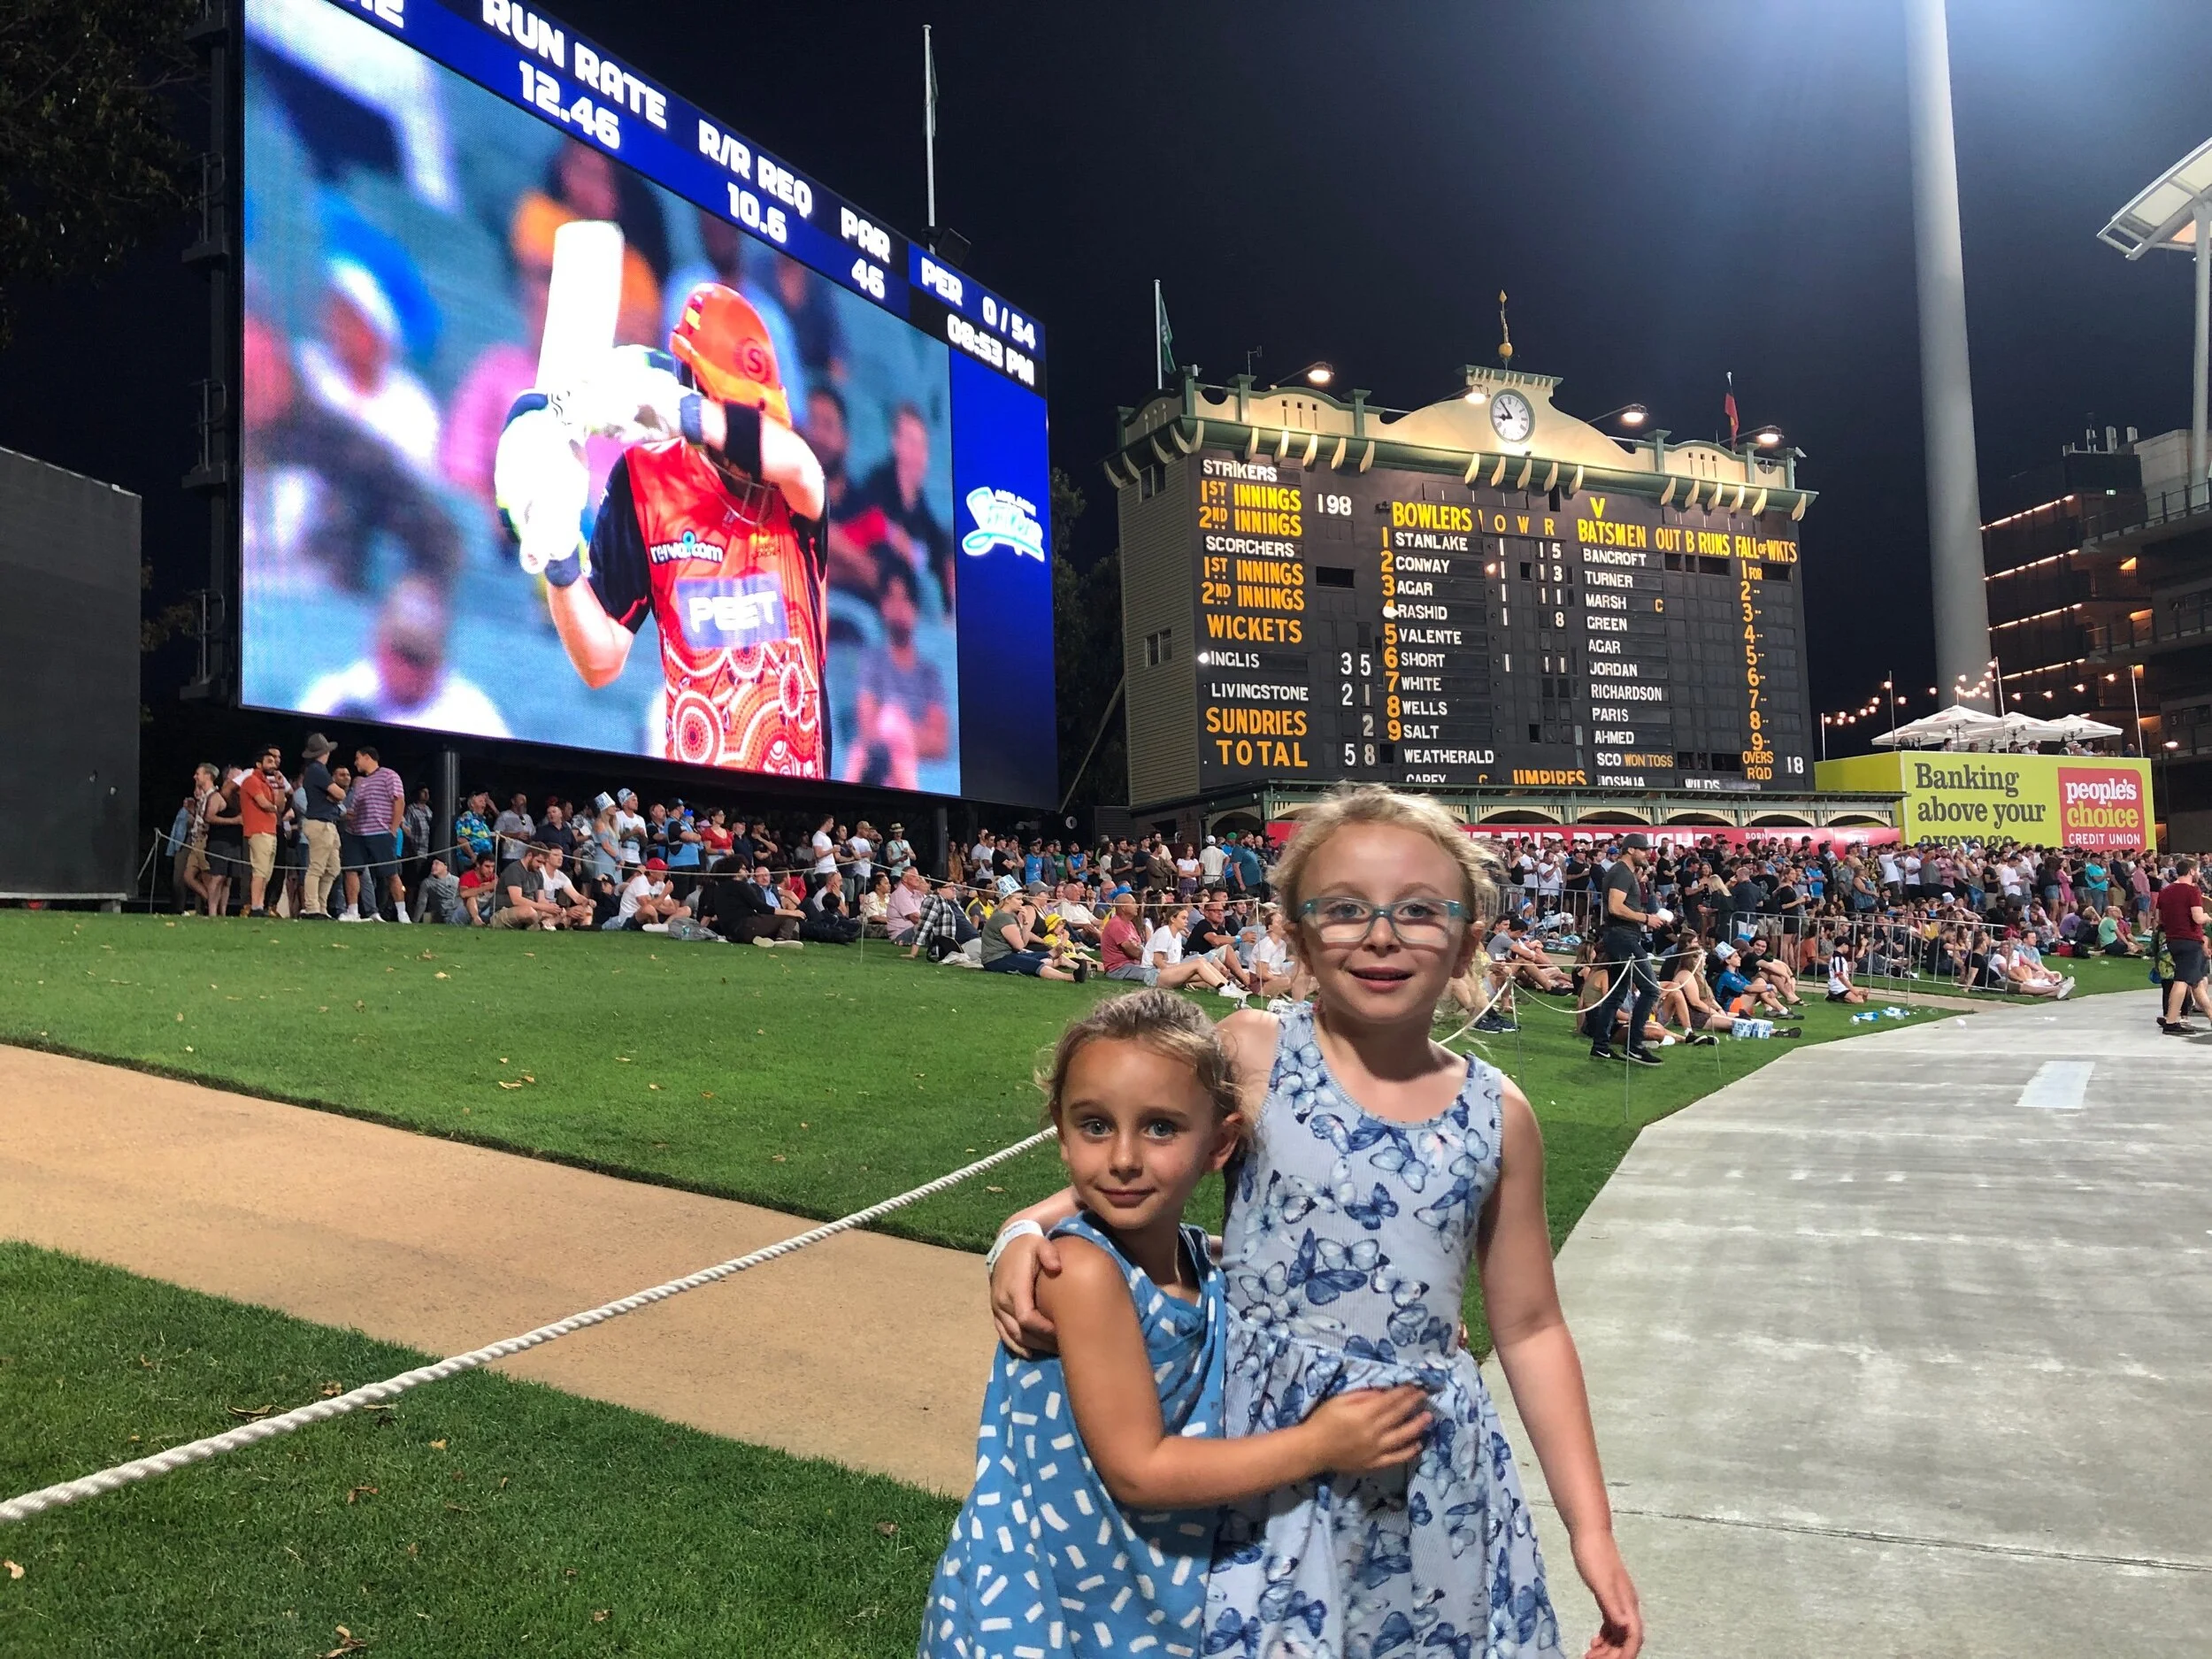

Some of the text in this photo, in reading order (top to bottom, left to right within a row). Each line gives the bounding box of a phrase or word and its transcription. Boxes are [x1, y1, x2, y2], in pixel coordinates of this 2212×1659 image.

[482, 0, 667, 129] RUN RATE
[518, 61, 620, 150] 12.46
[698, 119, 812, 218] R/R REQ
[727, 181, 787, 243] 10.6
[841, 206, 890, 264] PAR
[851, 258, 885, 299] 46
[921, 257, 963, 306] PER
[947, 313, 1034, 386] 08:53 PM
[1202, 459, 1277, 482] STRIKERS
[1202, 480, 1351, 516] 1ST INNINGS 198
[1590, 496, 1605, 518] V
[1199, 506, 1302, 537] 2ND INNINGS
[1392, 501, 1555, 535] BOWLERS O W R
[1205, 535, 1294, 558] SCORCHERS
[1382, 526, 1388, 548] 1
[1394, 531, 1468, 551] STANLAKE
[1577, 518, 1798, 564] BATSMEN OUT B RUNS FALL OF WKTS
[1380, 550, 1394, 572] 2
[1395, 556, 1450, 574] CONWAY
[1583, 548, 1647, 566] BANCROFT
[1203, 556, 1304, 586] 1ST INNINGS
[1585, 570, 1633, 588] TURNER
[1741, 559, 1763, 580] 1 FOR
[1201, 581, 1304, 611] 2ND INNINGS
[1381, 574, 1395, 597] 3
[1396, 580, 1432, 596] AGAR
[1740, 580, 1751, 601] 2
[688, 590, 778, 633] PEET
[1585, 594, 1663, 612] MARSH C
[1742, 603, 1754, 622] 3
[1398, 604, 1448, 620] RASHID
[1555, 612, 1564, 627] 8
[1586, 616, 1627, 632] GREEN
[1206, 613, 1302, 643] WICKETS
[1384, 623, 1462, 645] 5 VALENTE
[1744, 625, 1755, 643] 4
[1384, 646, 1398, 669] 6
[1401, 652, 1445, 668] SHORT
[1588, 639, 1621, 655] AGAR
[1746, 645, 1757, 665] 5
[1210, 650, 1260, 668] INGLIS
[1589, 662, 1637, 678] JORDAN
[1385, 671, 1442, 692] 7 WHITE
[1747, 667, 1759, 687] 6
[1211, 683, 1309, 702] LIVINGSTONE
[1591, 684, 1662, 702] RICHARDSON
[1748, 689, 1759, 709] 7
[1386, 695, 1448, 718] 8 WELLS
[1592, 707, 1629, 722] PARIS
[1206, 707, 1374, 737] SUNDRIES 2
[1387, 719, 1440, 741] 9 SALT
[1749, 710, 1761, 730] 8
[1594, 731, 1635, 745] AHMED
[1751, 733, 1763, 751] 9
[1216, 740, 1308, 767] TOTAL
[1403, 749, 1494, 764] WEATHERALD
[1596, 753, 1673, 768] SCO WON TOSS
[1742, 751, 1804, 774] OVERS 18
[1914, 763, 2020, 797] Banking
[2065, 778, 2137, 804] people's
[1917, 795, 2046, 829] above your
[2067, 801, 2139, 828] choice
[2069, 833, 2140, 844] CREDIT UNION
